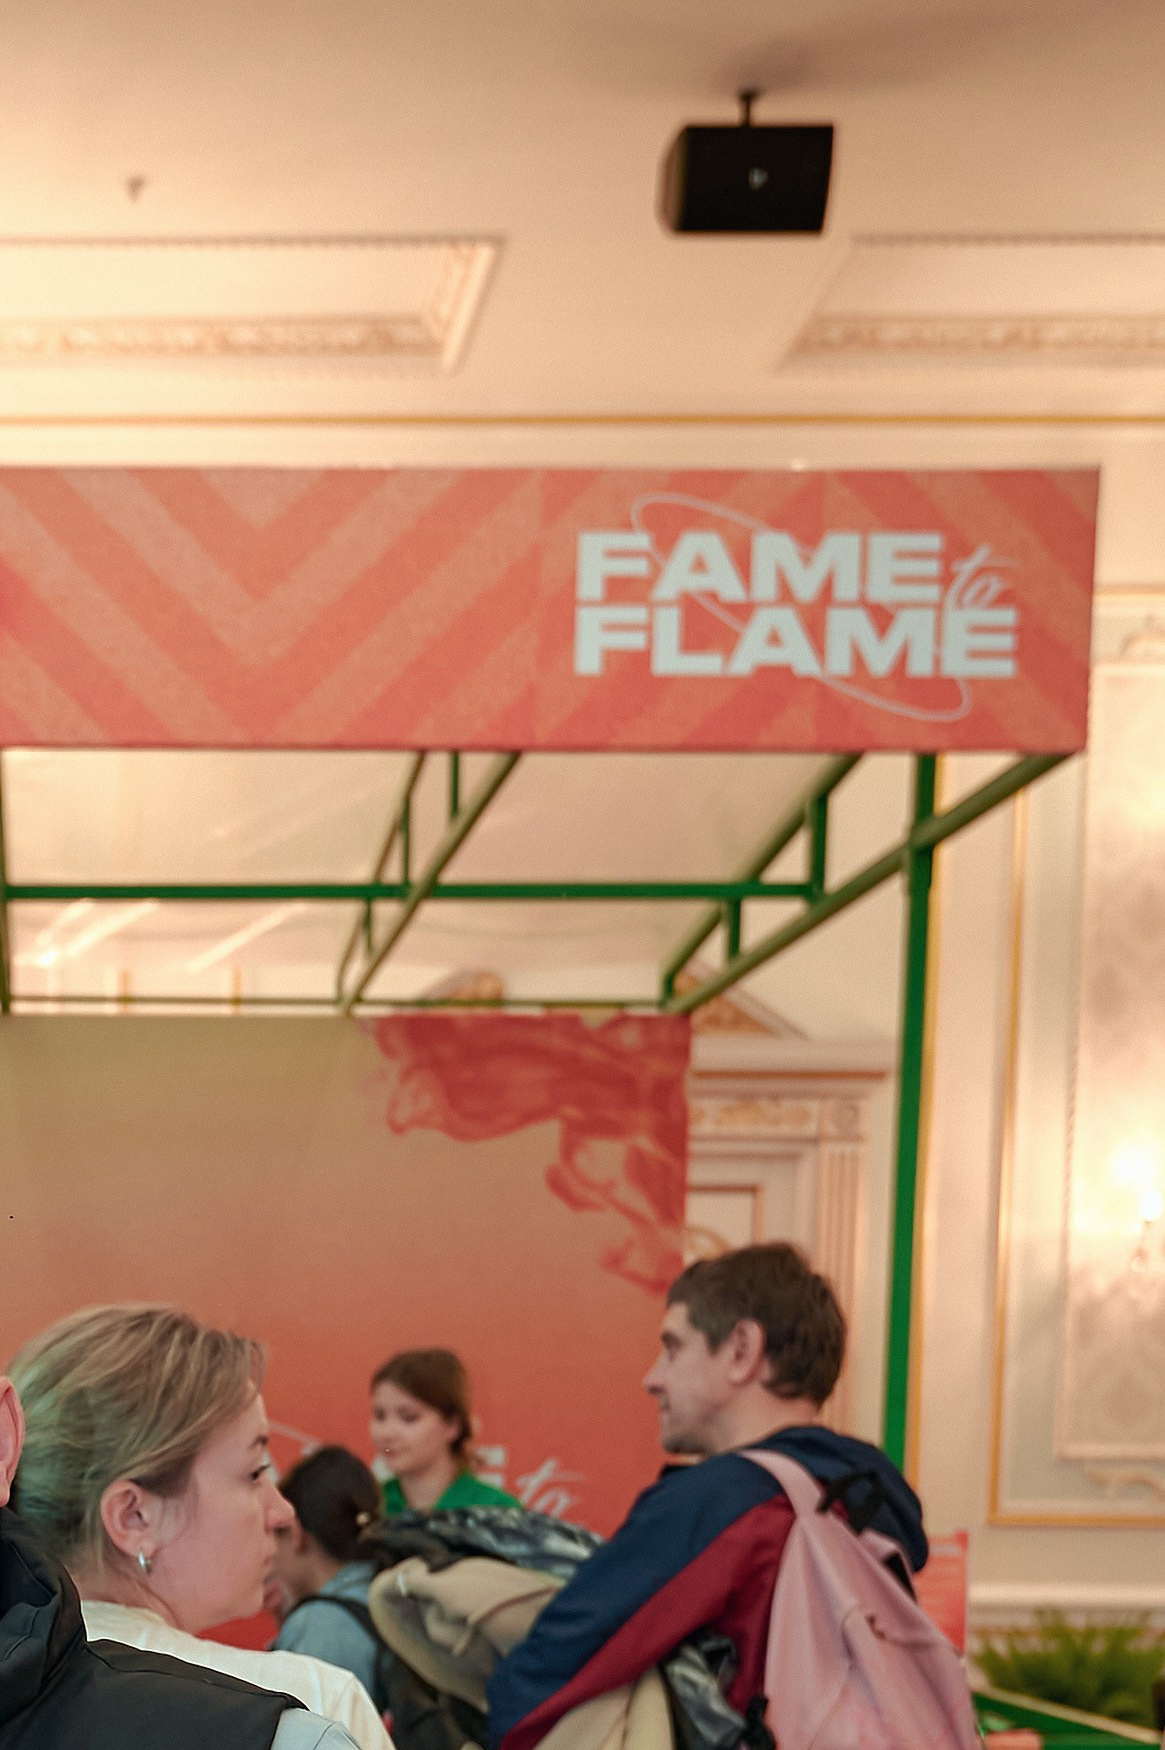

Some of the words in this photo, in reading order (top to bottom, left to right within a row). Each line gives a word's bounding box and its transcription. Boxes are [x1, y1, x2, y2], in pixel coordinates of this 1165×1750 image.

[576, 530, 944, 602] FAME
[945, 543, 1017, 610] to
[574, 605, 1018, 678] FLAME
